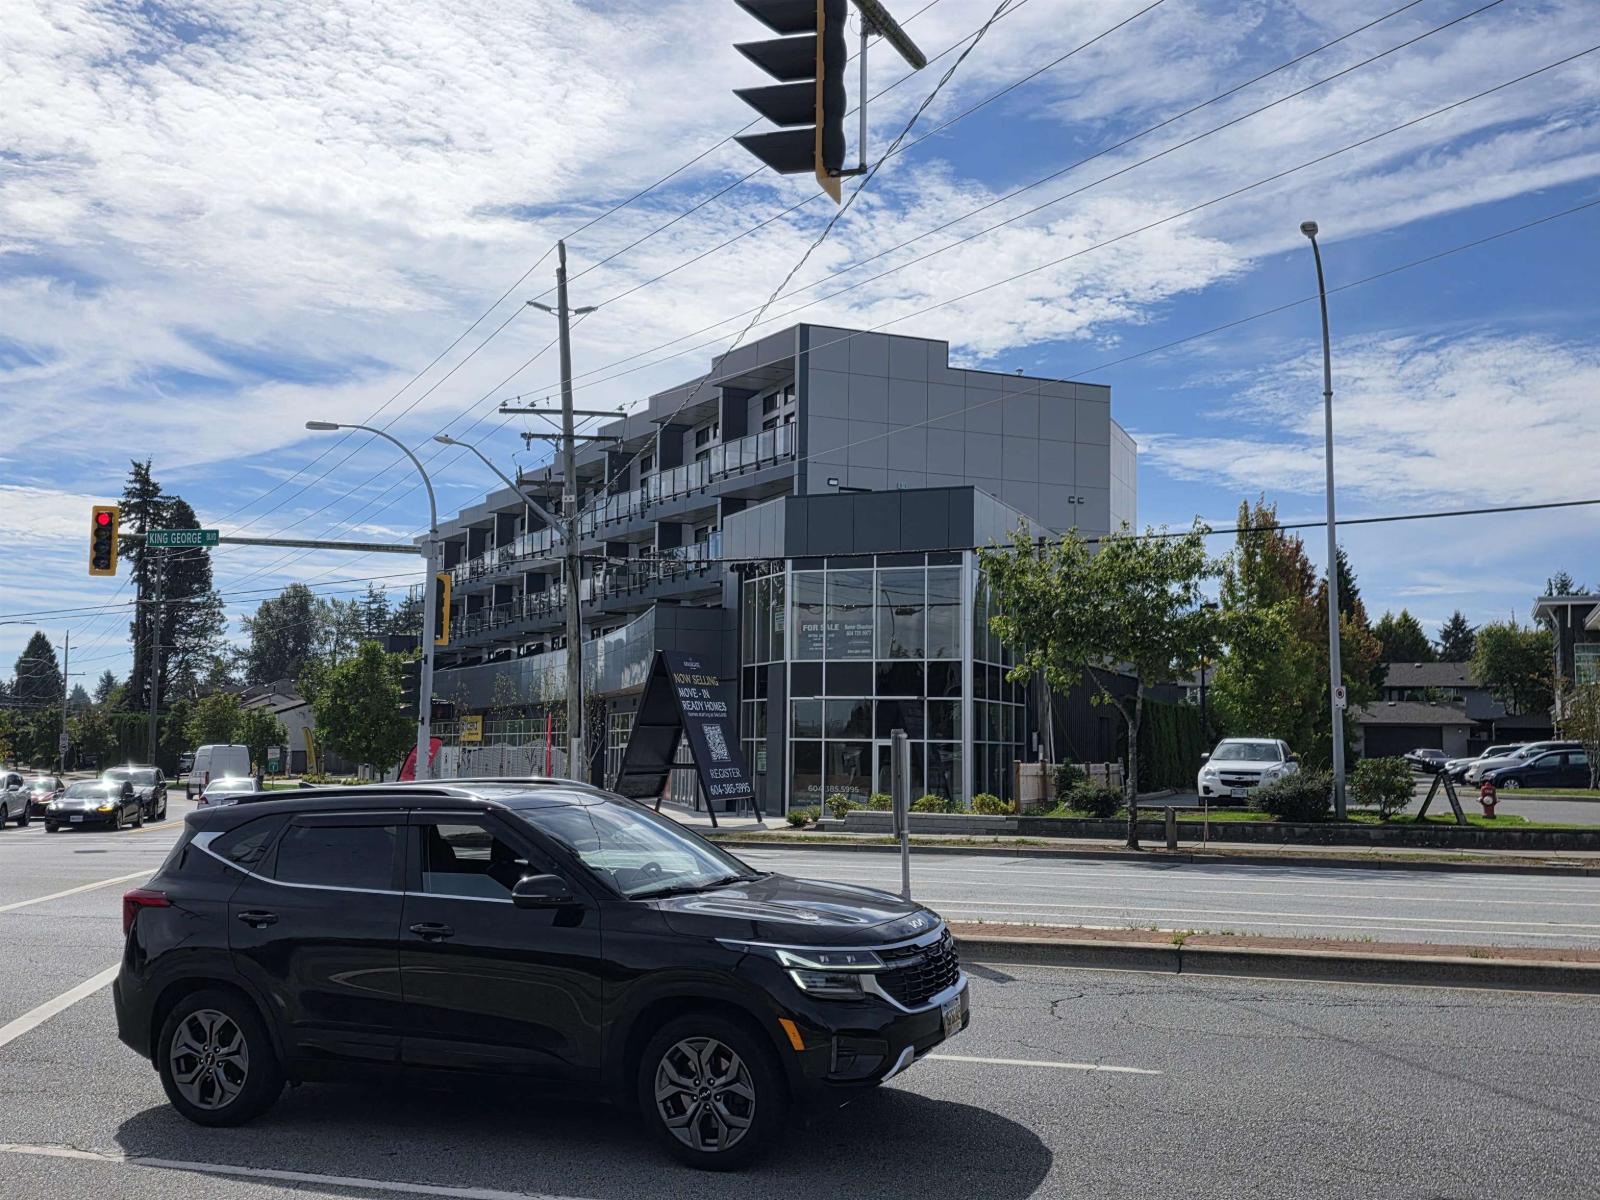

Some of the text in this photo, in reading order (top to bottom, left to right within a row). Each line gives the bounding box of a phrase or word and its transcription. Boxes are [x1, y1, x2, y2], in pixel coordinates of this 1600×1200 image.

[150, 532, 216, 544] KING GEORGE BLVD
[674, 673, 719, 686] NOW SELLING
[678, 687, 698, 698] MOVE
[701, 688, 711, 699] IN
[682, 700, 727, 712] READY HOMES
[710, 768, 742, 778] REGISTER
[808, 784, 860, 792] 604385.5995
